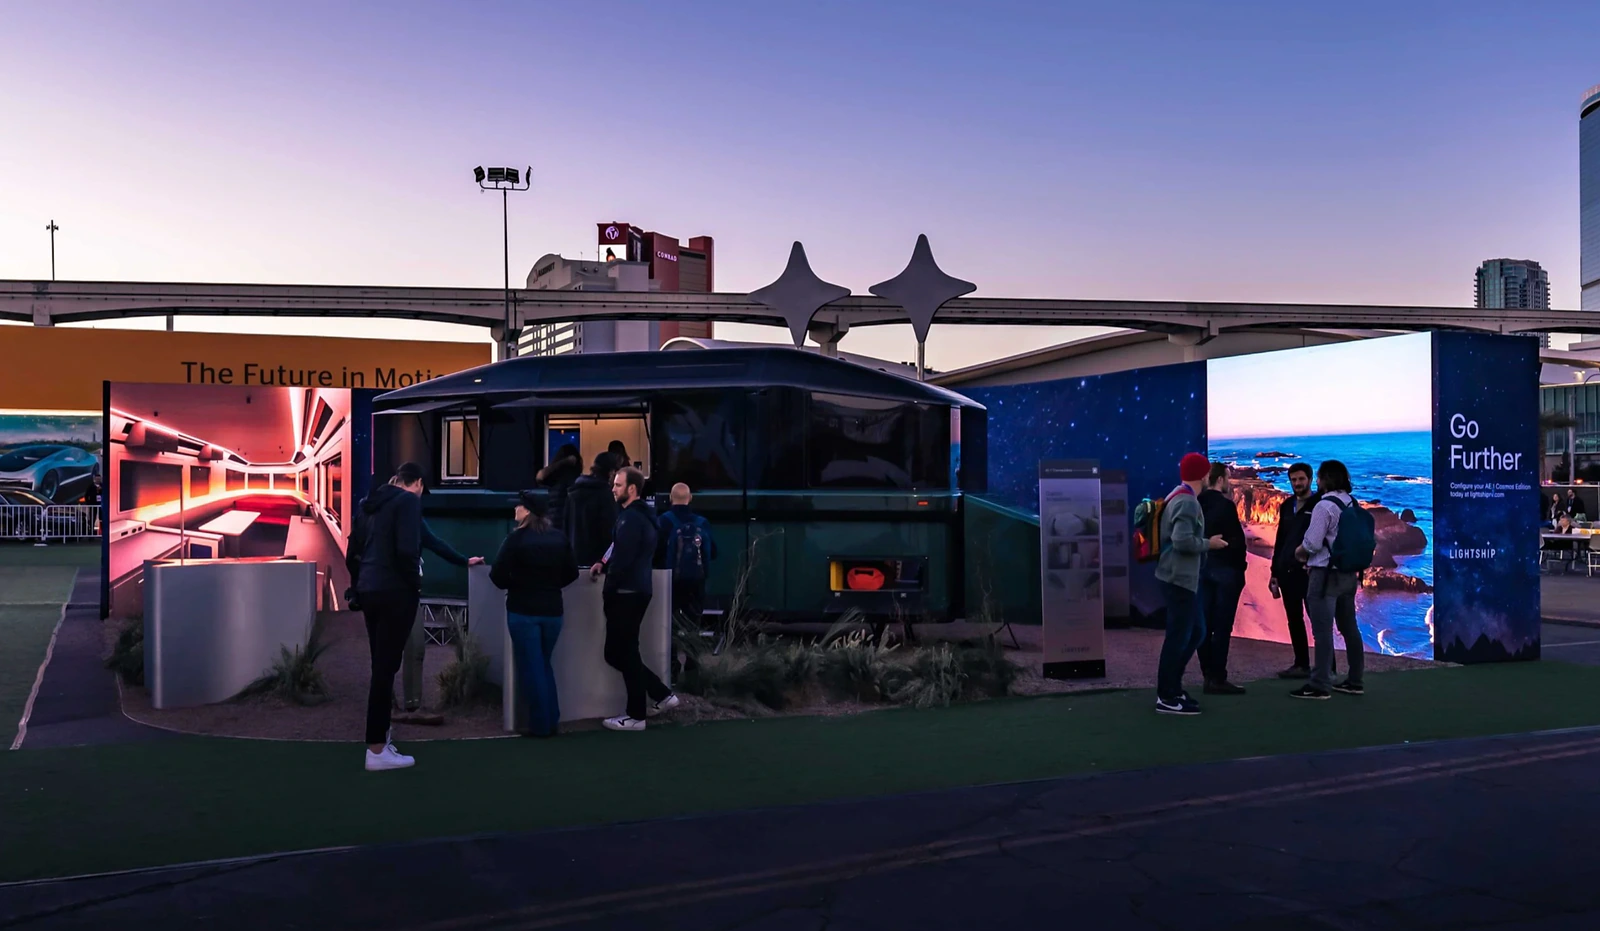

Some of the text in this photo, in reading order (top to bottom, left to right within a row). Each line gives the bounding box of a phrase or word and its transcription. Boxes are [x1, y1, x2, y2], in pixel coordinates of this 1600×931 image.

[657, 250, 678, 262] CONRAD
[181, 362, 445, 389] The Future in Moti
[1450, 413, 1479, 439] Go
[1451, 444, 1522, 471] Further
[1450, 482, 1473, 491] Configure
[1515, 482, 1532, 490] Edition
[1450, 491, 1464, 499] today
[1449, 548, 1496, 559] LIGHTSHIP
